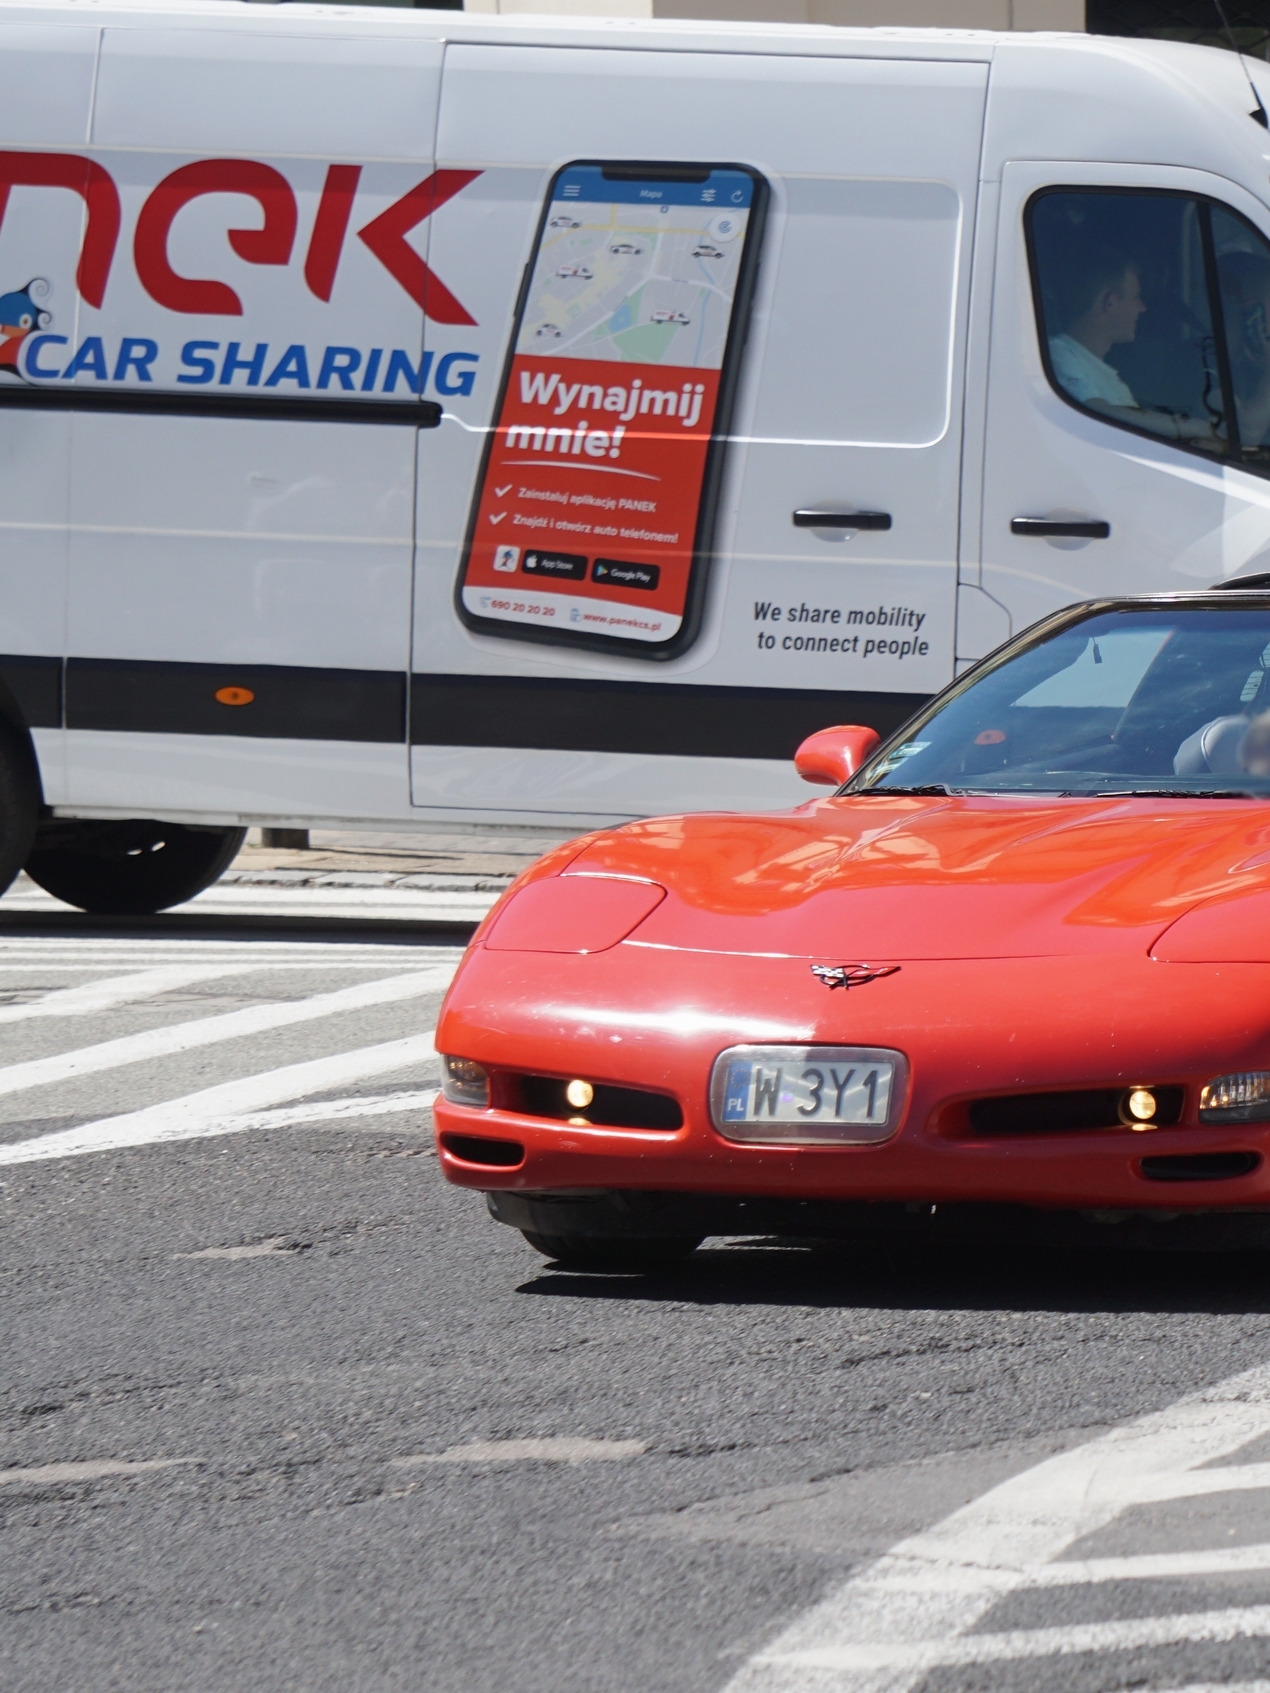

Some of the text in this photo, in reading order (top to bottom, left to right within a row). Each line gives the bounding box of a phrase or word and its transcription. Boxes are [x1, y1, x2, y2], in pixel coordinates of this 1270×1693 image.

[24, 334, 480, 397] CAR SHARING
[519, 371, 705, 427] Wynajmij
[504, 420, 627, 459] mnie!
[518, 487, 657, 512] Zainstaluj aplikację PANEK
[550, 518, 554, 528] i
[555, 519, 592, 534] otwórz
[593, 526, 618, 537] auto
[619, 527, 679, 544] telefonem!
[541, 559, 574, 571] App Store
[610, 568, 652, 583] Google Play
[491, 599, 556, 617] 690 20 20 20
[754, 602, 926, 632] We share mobility
[757, 632, 929, 660] to connect people
[727, 1098, 745, 1111] PL
[753, 1067, 879, 1118] W 3Y1
